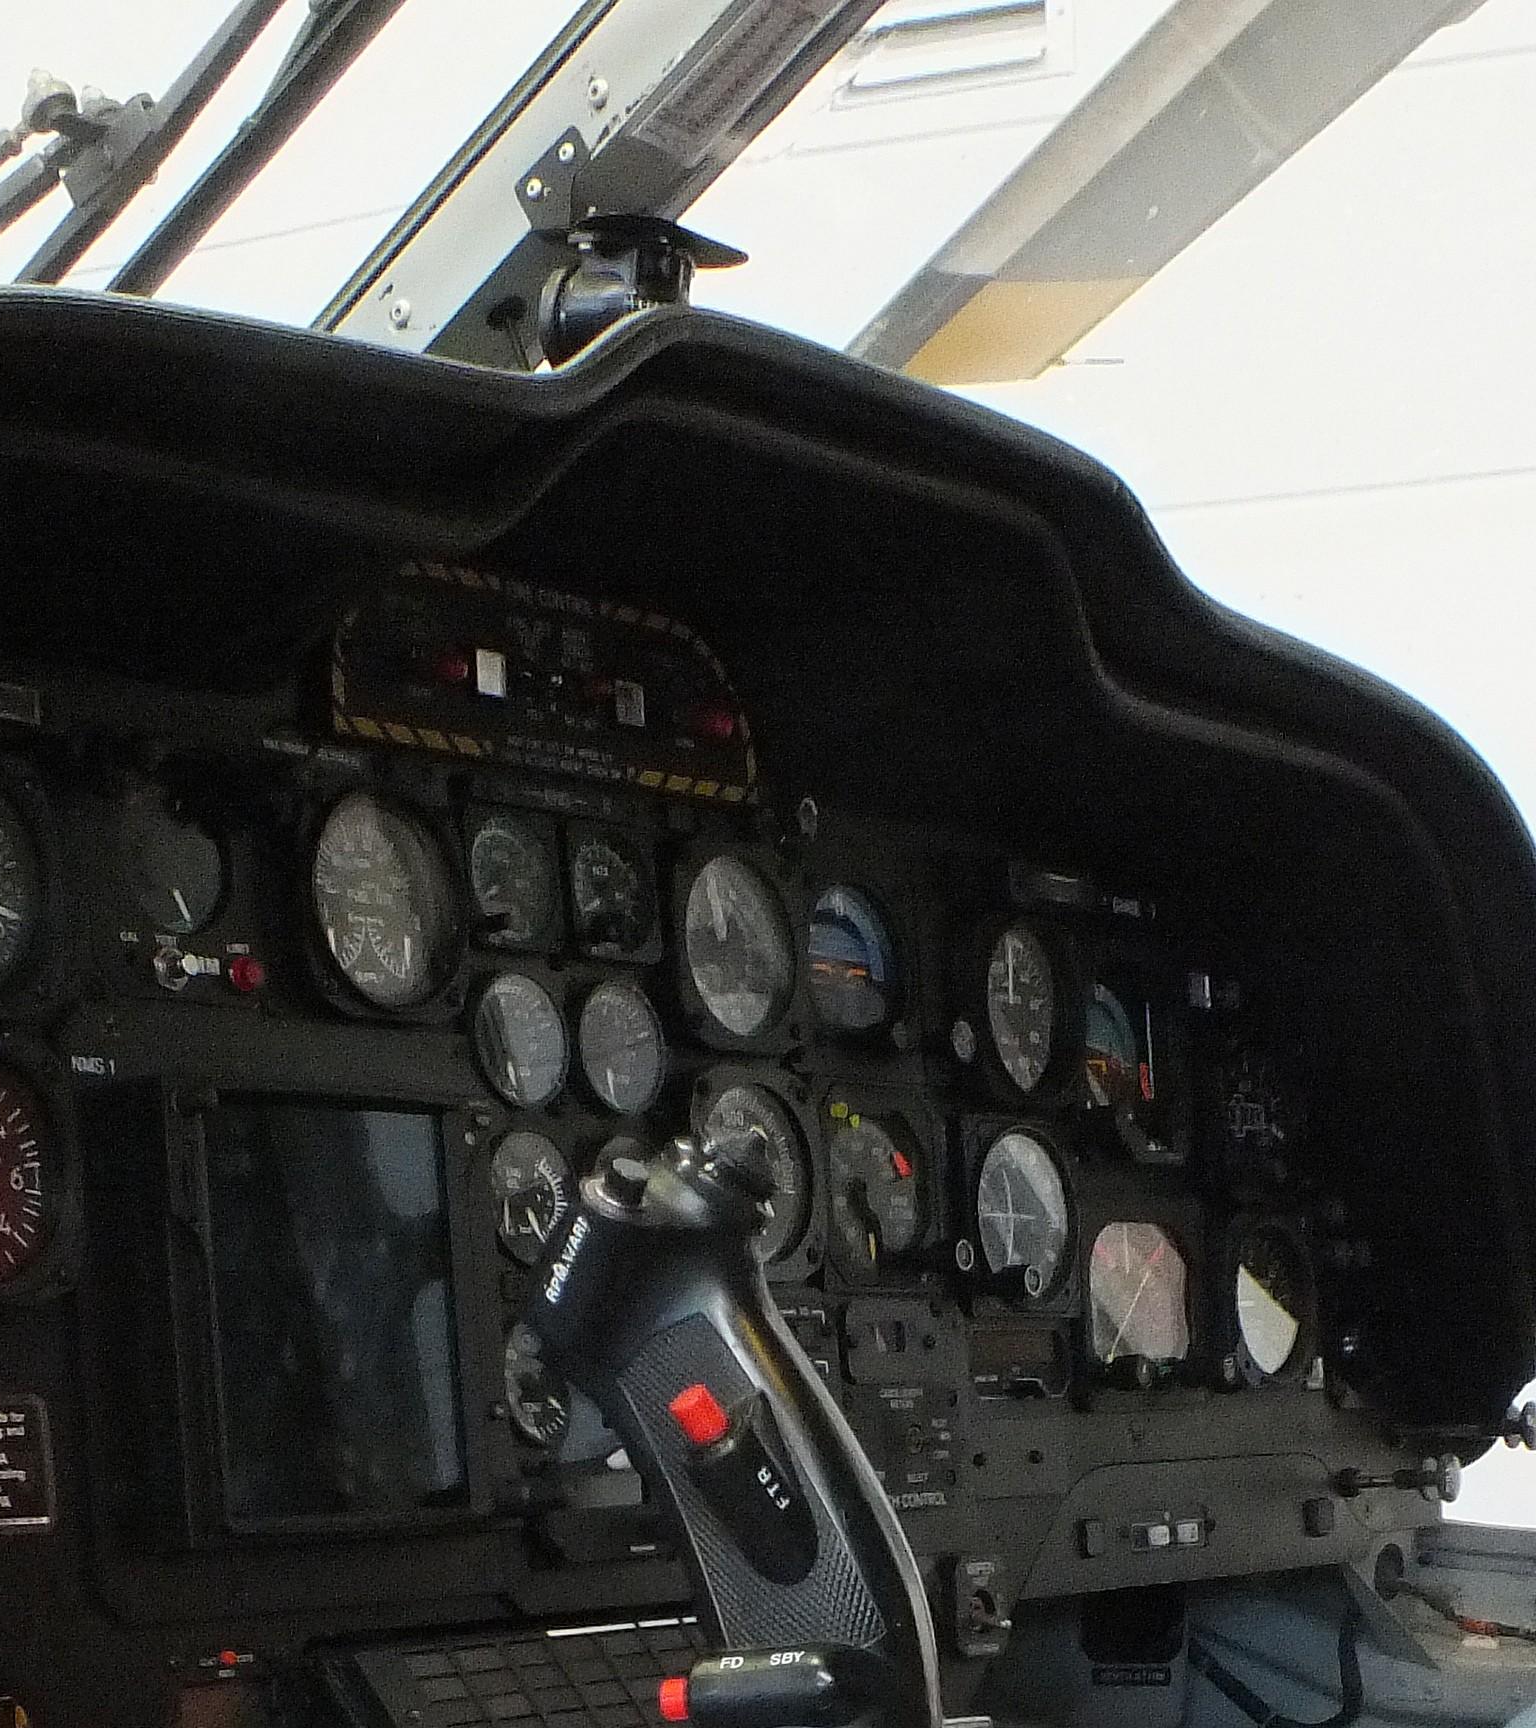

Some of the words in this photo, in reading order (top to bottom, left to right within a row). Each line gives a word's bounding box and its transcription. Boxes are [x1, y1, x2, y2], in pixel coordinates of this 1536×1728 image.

[10, 1168, 25, 1191] 6
[719, 1656, 744, 1670] FD
[769, 1650, 805, 1666] SBY
